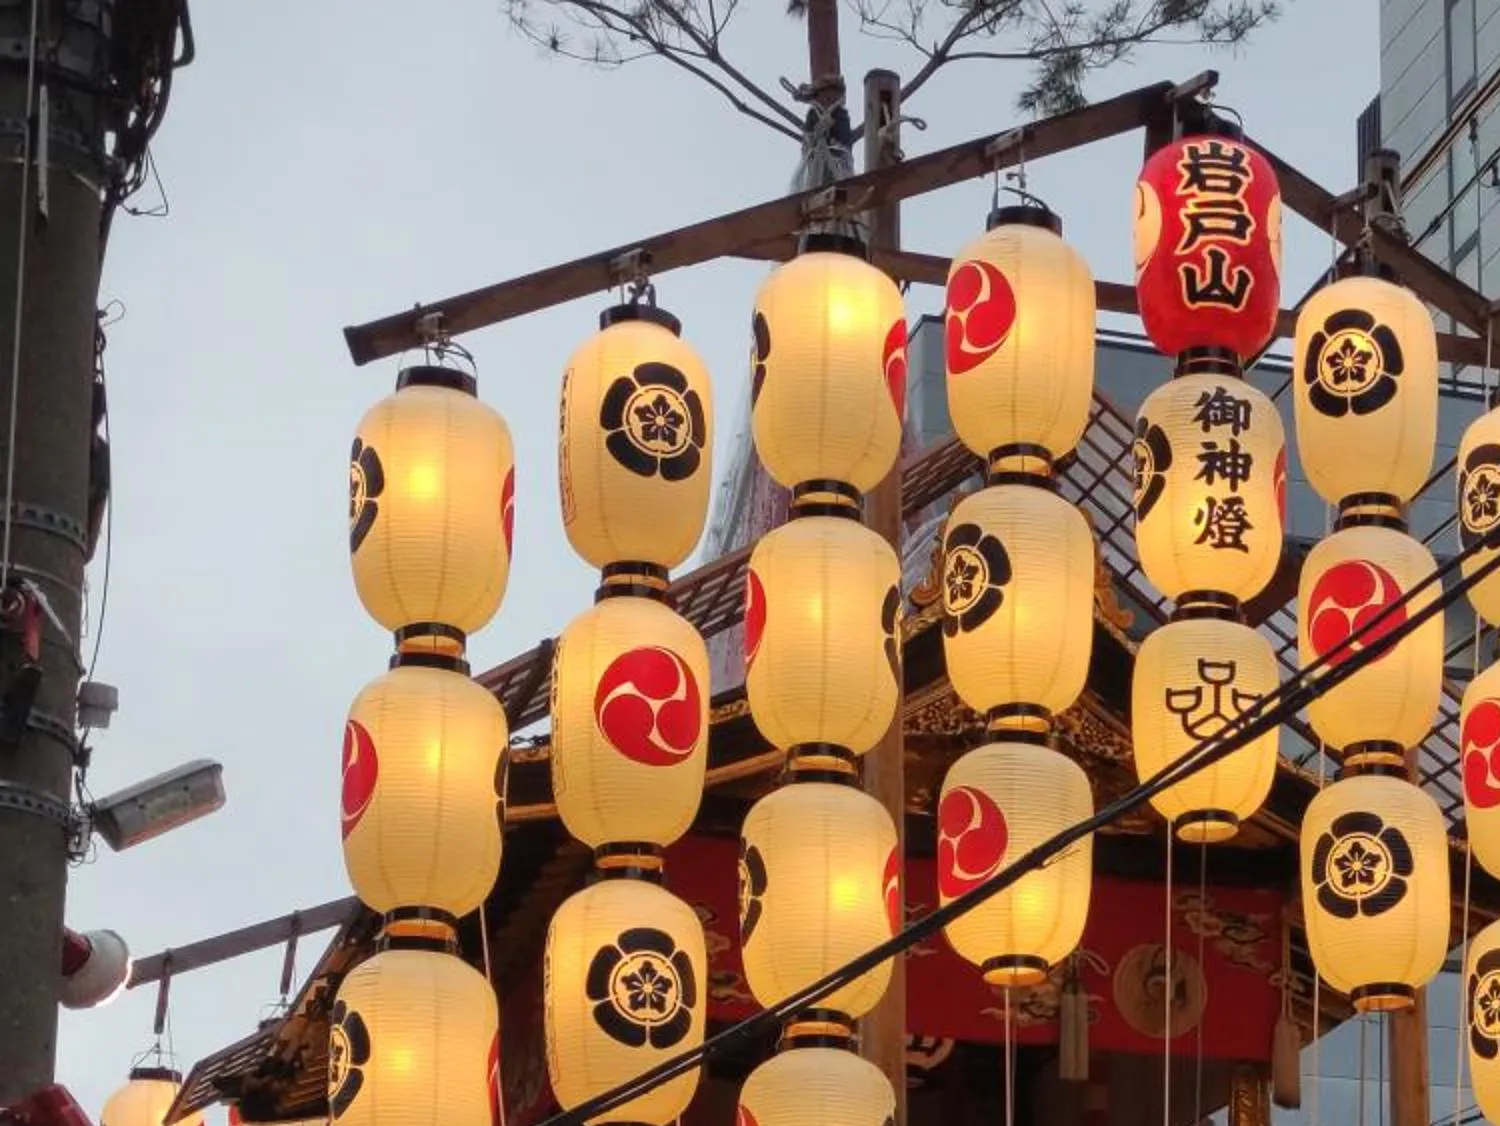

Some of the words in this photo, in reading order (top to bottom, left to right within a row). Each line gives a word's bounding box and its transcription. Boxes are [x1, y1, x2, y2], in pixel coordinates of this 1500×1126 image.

[1176, 140, 1254, 310] 岩戸山
[1193, 386, 1254, 554] 御神燈
